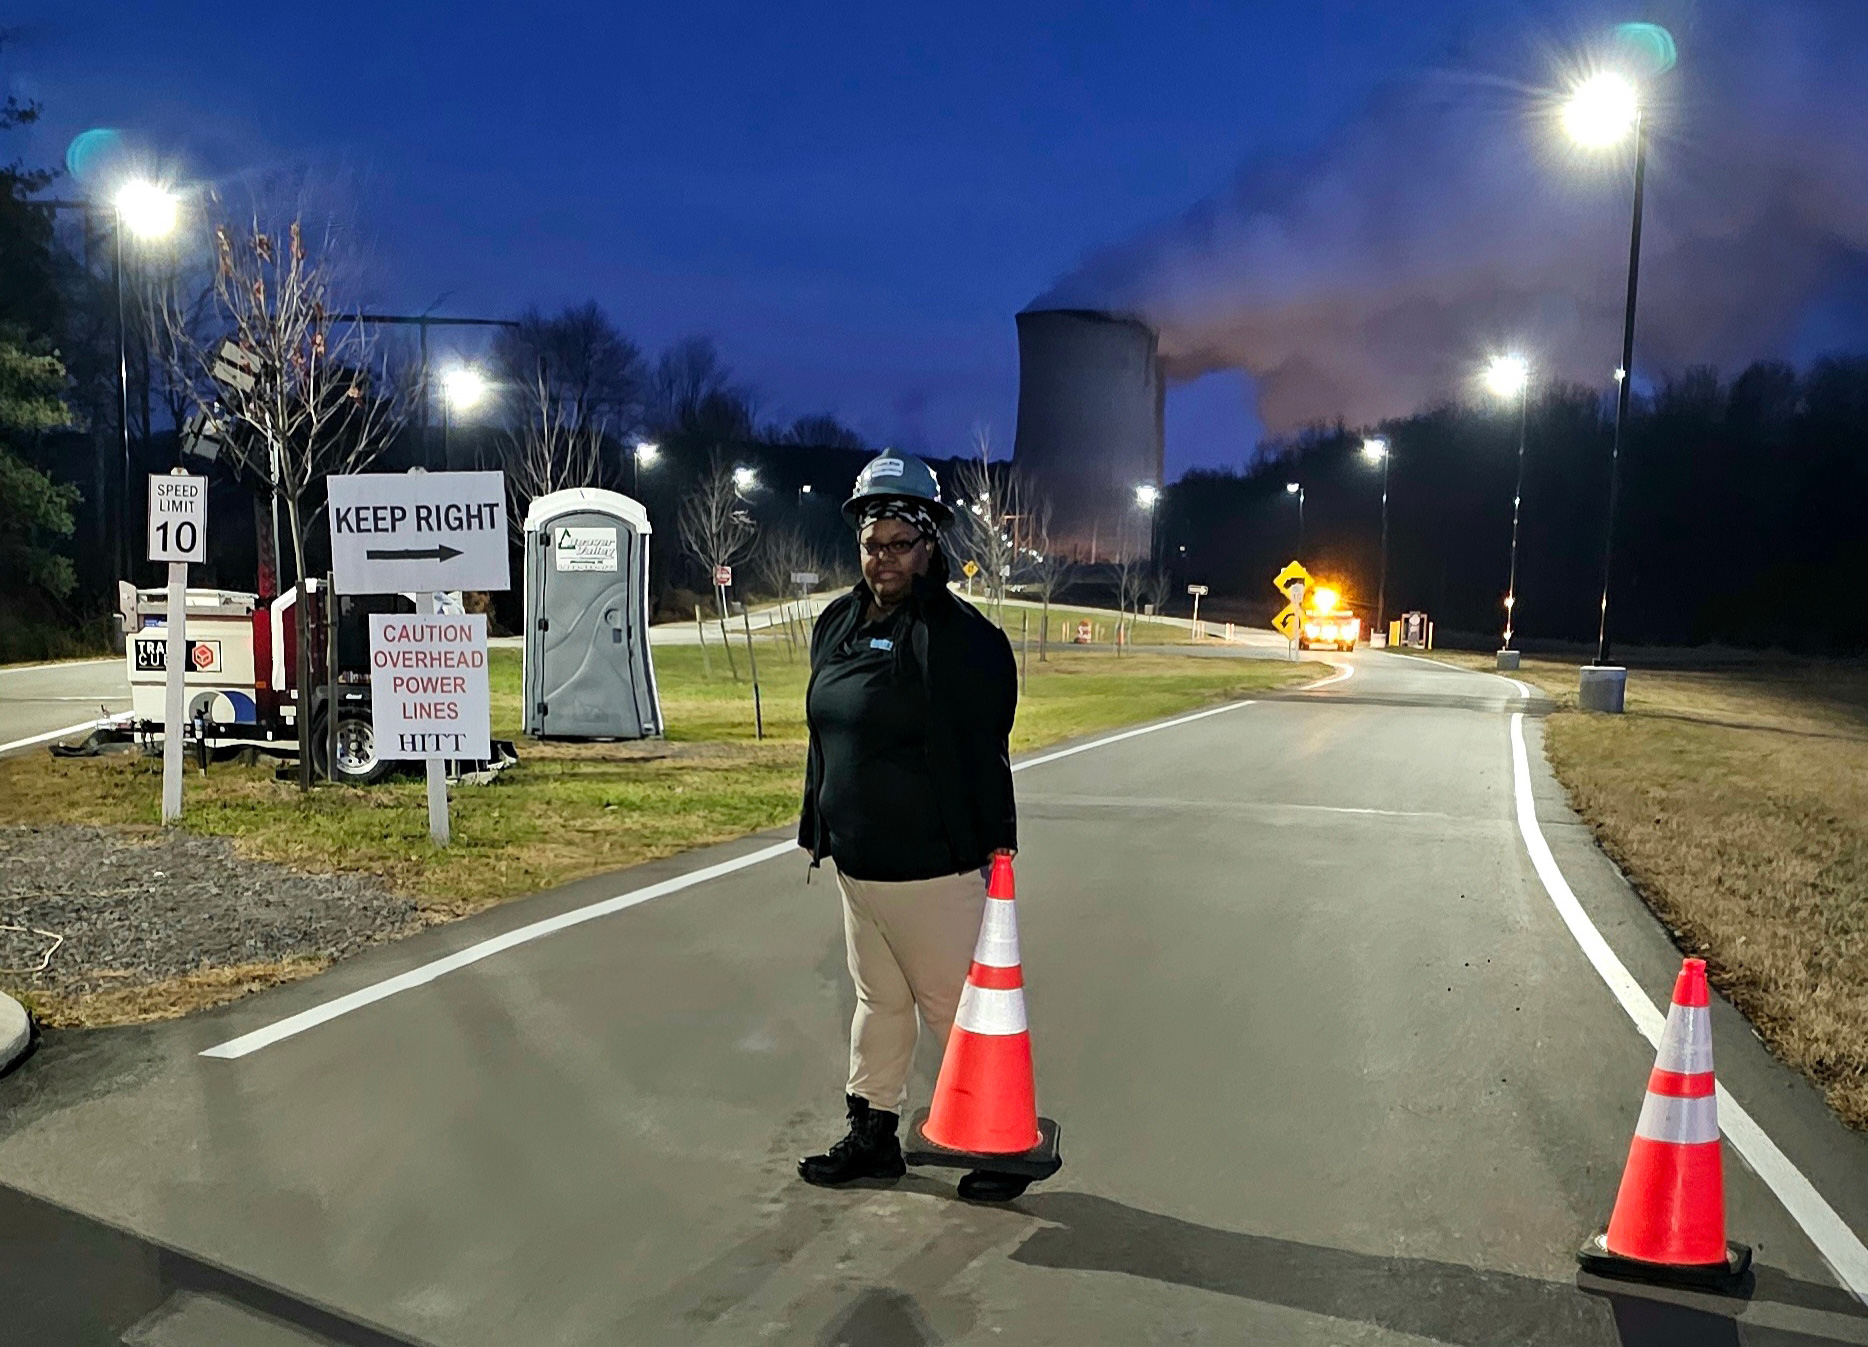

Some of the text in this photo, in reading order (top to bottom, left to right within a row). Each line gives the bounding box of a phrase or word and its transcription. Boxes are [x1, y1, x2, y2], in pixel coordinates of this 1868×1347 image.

[157, 484, 199, 498] SPEED
[159, 500, 194, 513] LIMIT
[335, 503, 499, 533] KEEP RIGHT
[155, 521, 197, 553] 10
[383, 624, 472, 643] CAUTION
[138, 641, 167, 654] TRA
[374, 650, 484, 668] OVERHEAD
[393, 676, 466, 694] POWER
[402, 702, 459, 719] LINES
[398, 733, 467, 753] HITT
